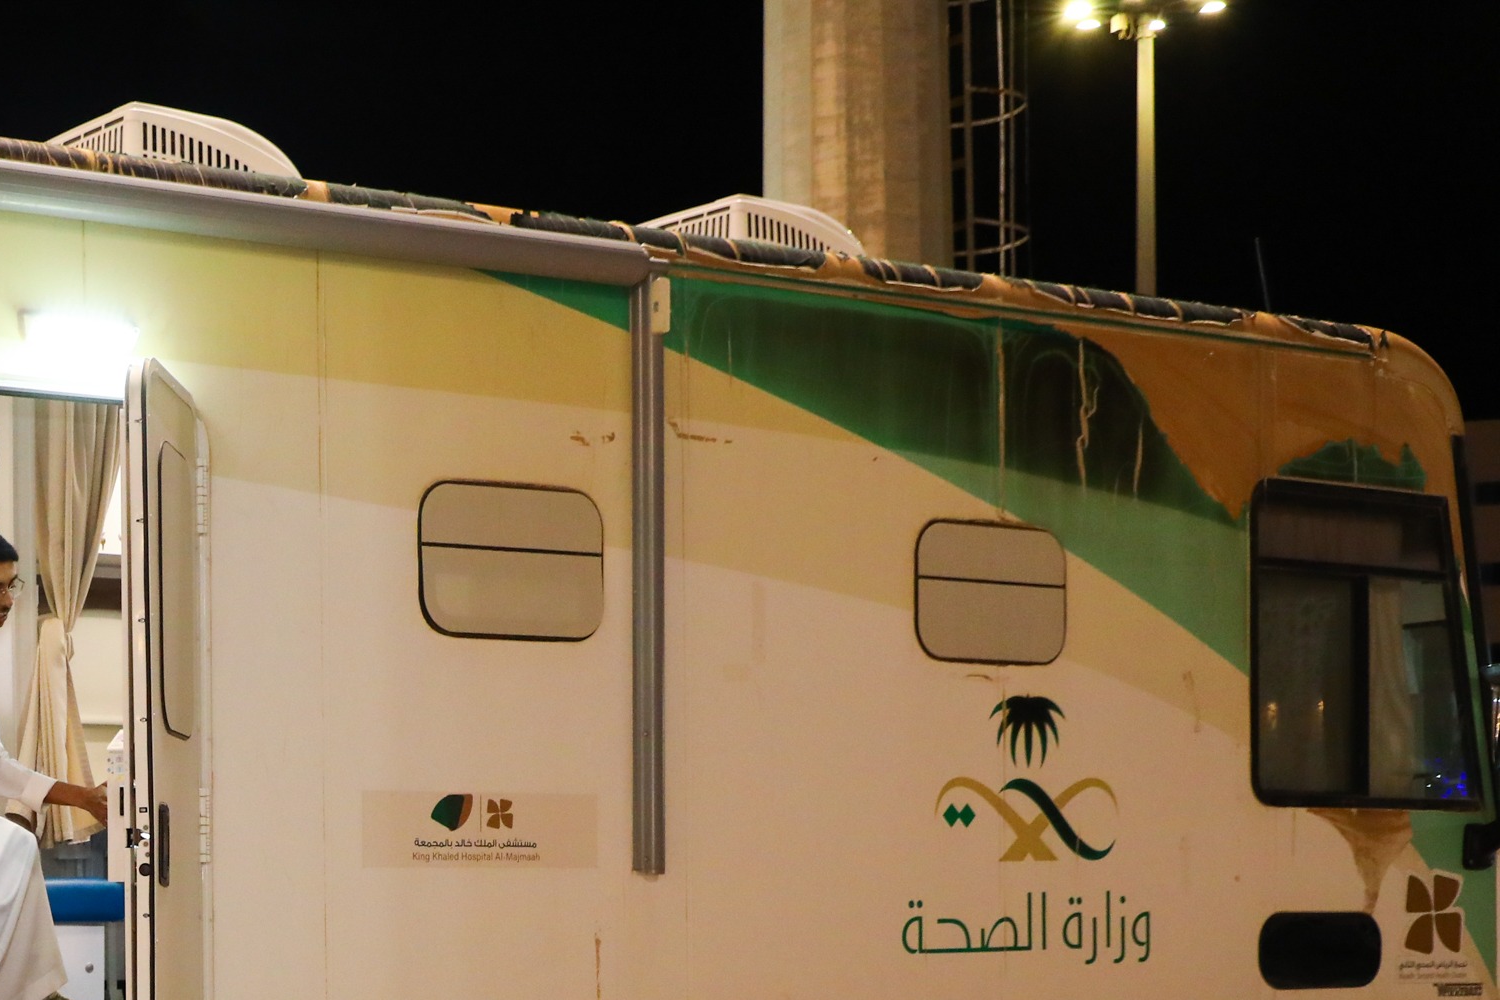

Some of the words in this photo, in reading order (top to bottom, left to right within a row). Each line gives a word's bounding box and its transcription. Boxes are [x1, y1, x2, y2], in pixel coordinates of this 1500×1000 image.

[413, 838, 453, 849] بالمجمعة
[454, 839, 473, 848] خالد
[474, 839, 497, 849] الملك
[498, 838, 538, 850] مستشفى
[412, 852, 431, 863] King
[432, 852, 460, 861] Khaled
[461, 852, 493, 863] Hospital
[902, 892, 1046, 954] الصحة
[1063, 891, 1150, 964] وزارة
